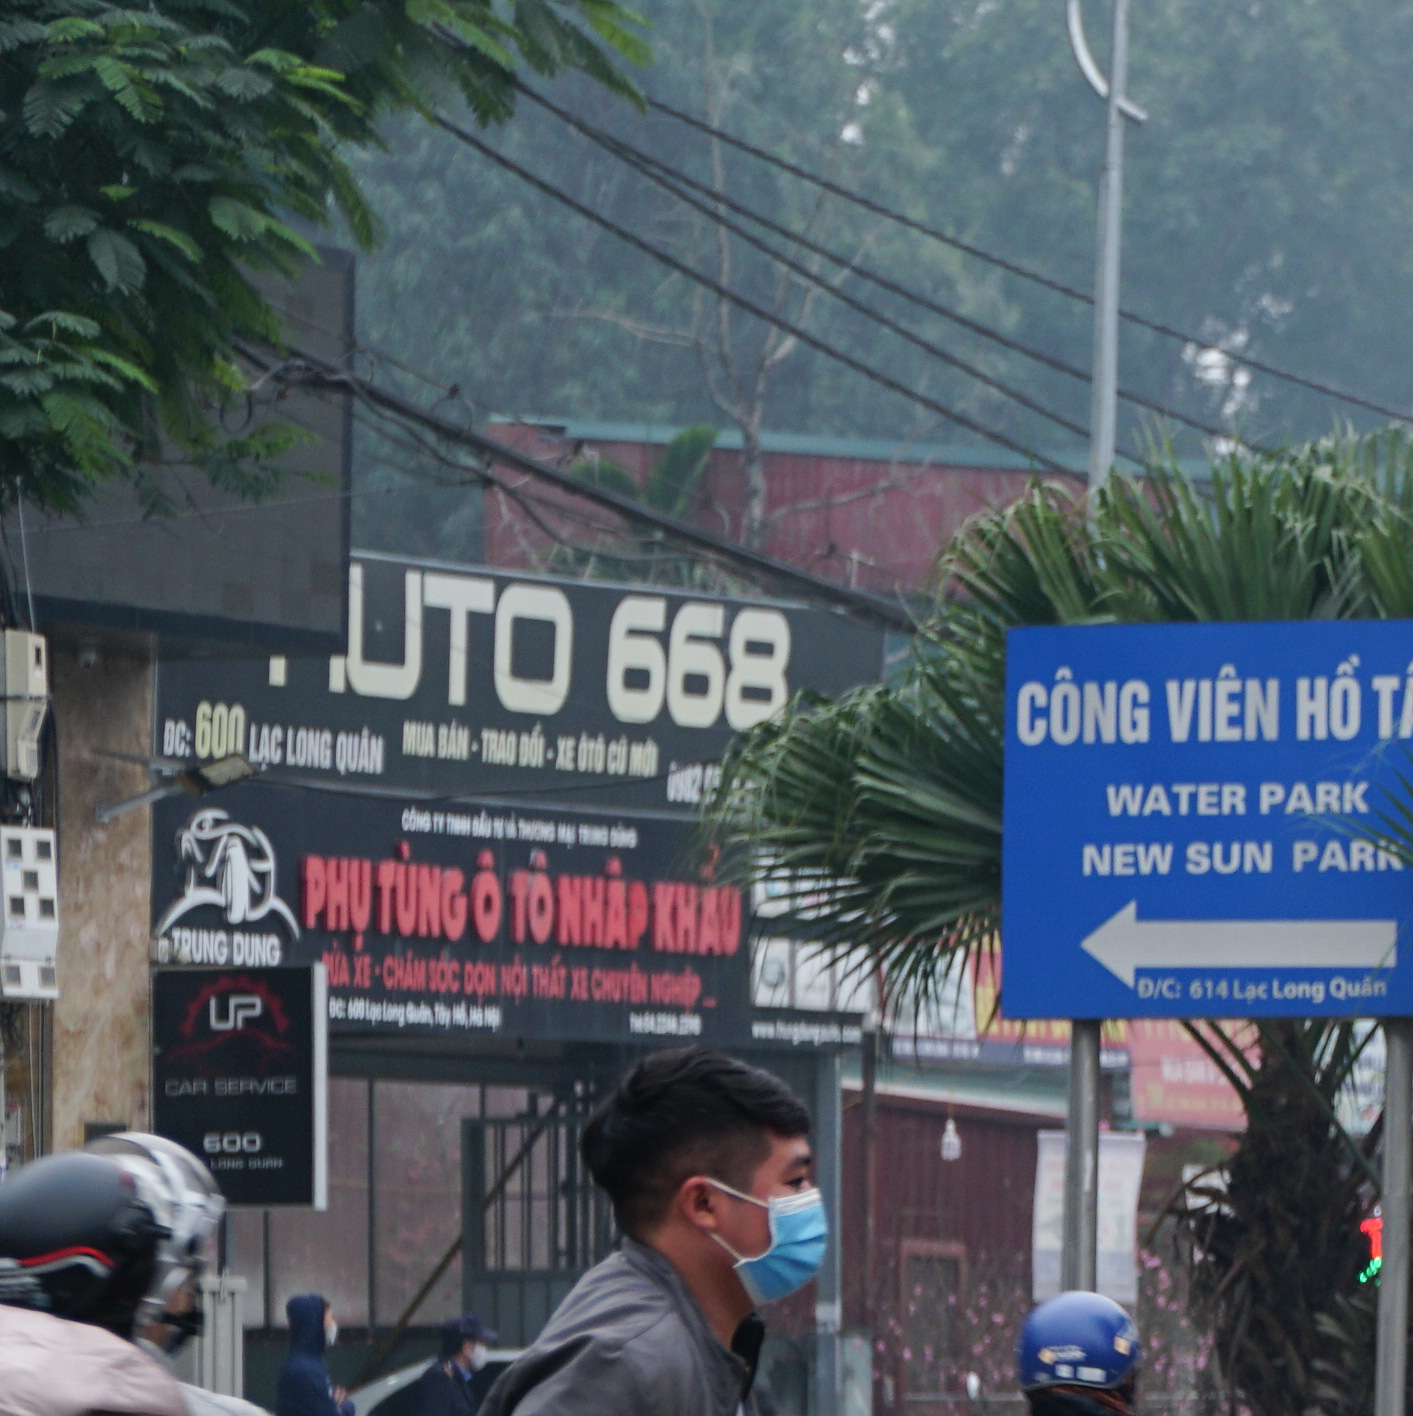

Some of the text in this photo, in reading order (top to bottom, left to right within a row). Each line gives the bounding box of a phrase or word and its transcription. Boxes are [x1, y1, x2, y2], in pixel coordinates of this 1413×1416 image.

[268, 561, 792, 733] UTO 668
[1016, 665, 1152, 747] CÔNG
[1166, 663, 1280, 743] VIÊN
[194, 699, 247, 760] 600
[249, 721, 284, 772] LẠC
[285, 724, 334, 771] LONG
[334, 725, 386, 776] QUÂN
[401, 718, 436, 758] MUA
[480, 727, 518, 767] TRAO
[555, 734, 577, 772] XE
[1105, 780, 1370, 817] WATER PARK
[1081, 840, 1406, 877] NEW SUN PARK
[304, 853, 372, 952] PHỤ
[470, 847, 503, 944] Ô
[508, 847, 555, 946] TÔ
[352, 954, 372, 989] XE
[463, 959, 497, 1004] DỌN
[1188, 976, 1230, 1001] 614
[1232, 977, 1268, 1005] Lạc
[1271, 977, 1326, 1005] Long
[208, 994, 262, 1031] UP
[164, 1074, 298, 1098] CAR SERVICE
[202, 1131, 263, 1154] 600
